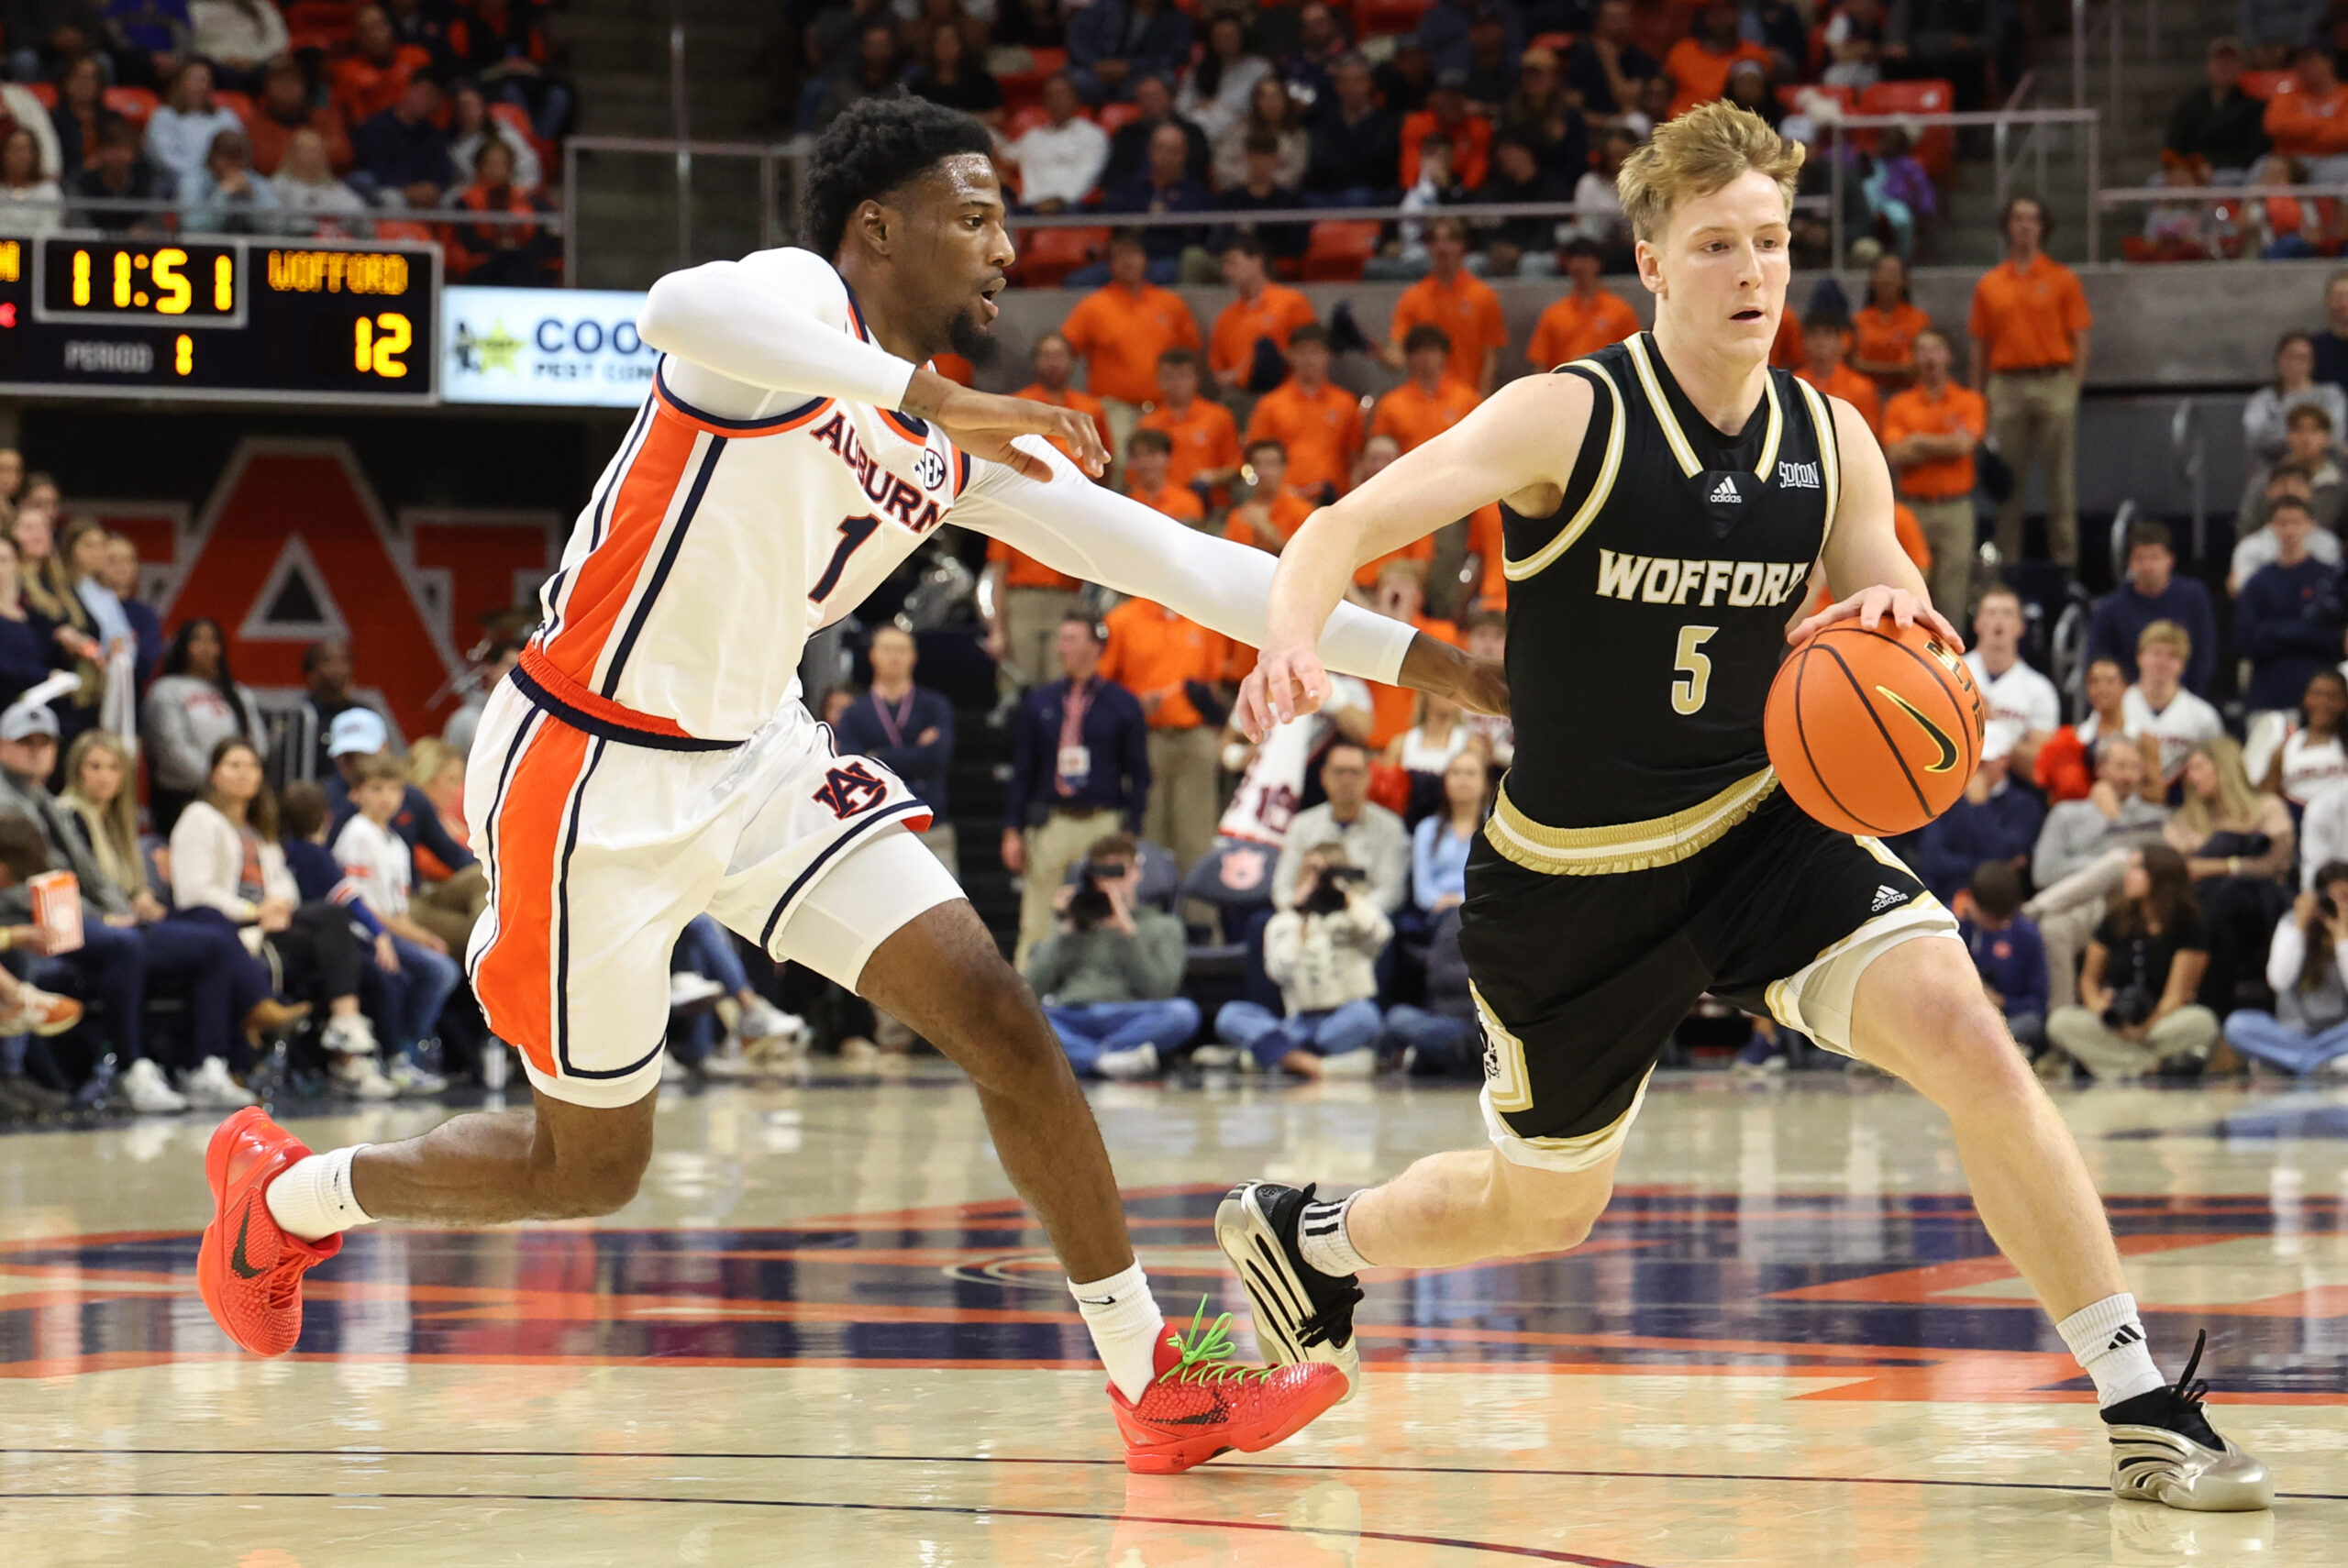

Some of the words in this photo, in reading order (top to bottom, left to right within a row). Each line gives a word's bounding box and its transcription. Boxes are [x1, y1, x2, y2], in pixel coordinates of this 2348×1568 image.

[72, 248, 233, 315] 11:51
[267, 249, 409, 295] WOFFORD
[64, 339, 154, 373] PERIOD
[175, 334, 193, 376] 1
[355, 313, 412, 378] 12
[536, 319, 659, 357] COO
[809, 410, 952, 534] AUBURN
[1710, 492, 1743, 503] adidas
[1778, 460, 1821, 489] SOCON
[807, 513, 882, 604] 1
[1596, 547, 1811, 607] WOFFORD
[1670, 624, 1720, 715] 5
[1871, 892, 1909, 912] adidas
